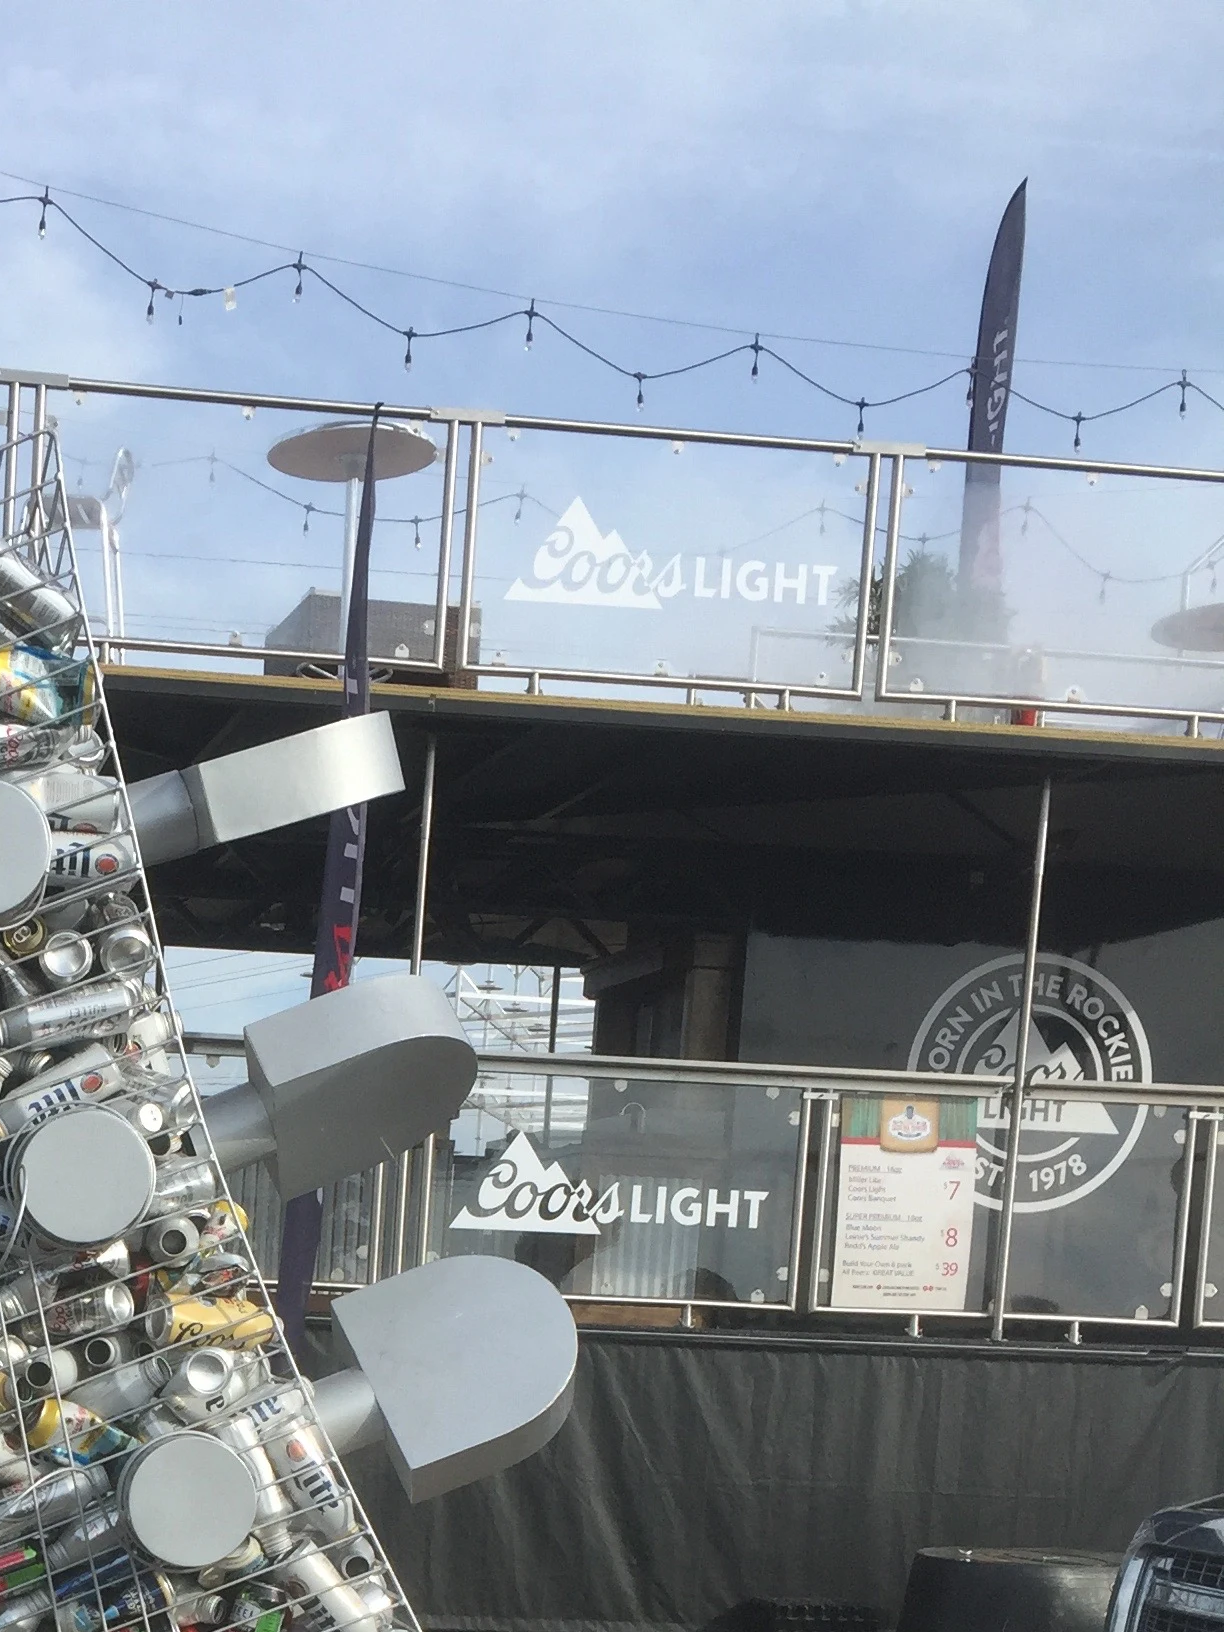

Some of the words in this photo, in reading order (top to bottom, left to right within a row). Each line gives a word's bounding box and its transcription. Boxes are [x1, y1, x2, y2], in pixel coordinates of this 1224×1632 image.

[520, 525, 687, 599] Coors
[693, 556, 839, 606] LIGHT
[928, 1004, 974, 1073] ORN
[971, 980, 1005, 1014] IN
[1008, 973, 1065, 999] THE
[1064, 983, 1134, 1083] ROCKIE
[465, 1158, 625, 1224] Coors
[630, 1184, 770, 1229] LIGHT
[1029, 1153, 1088, 1193] 1978
